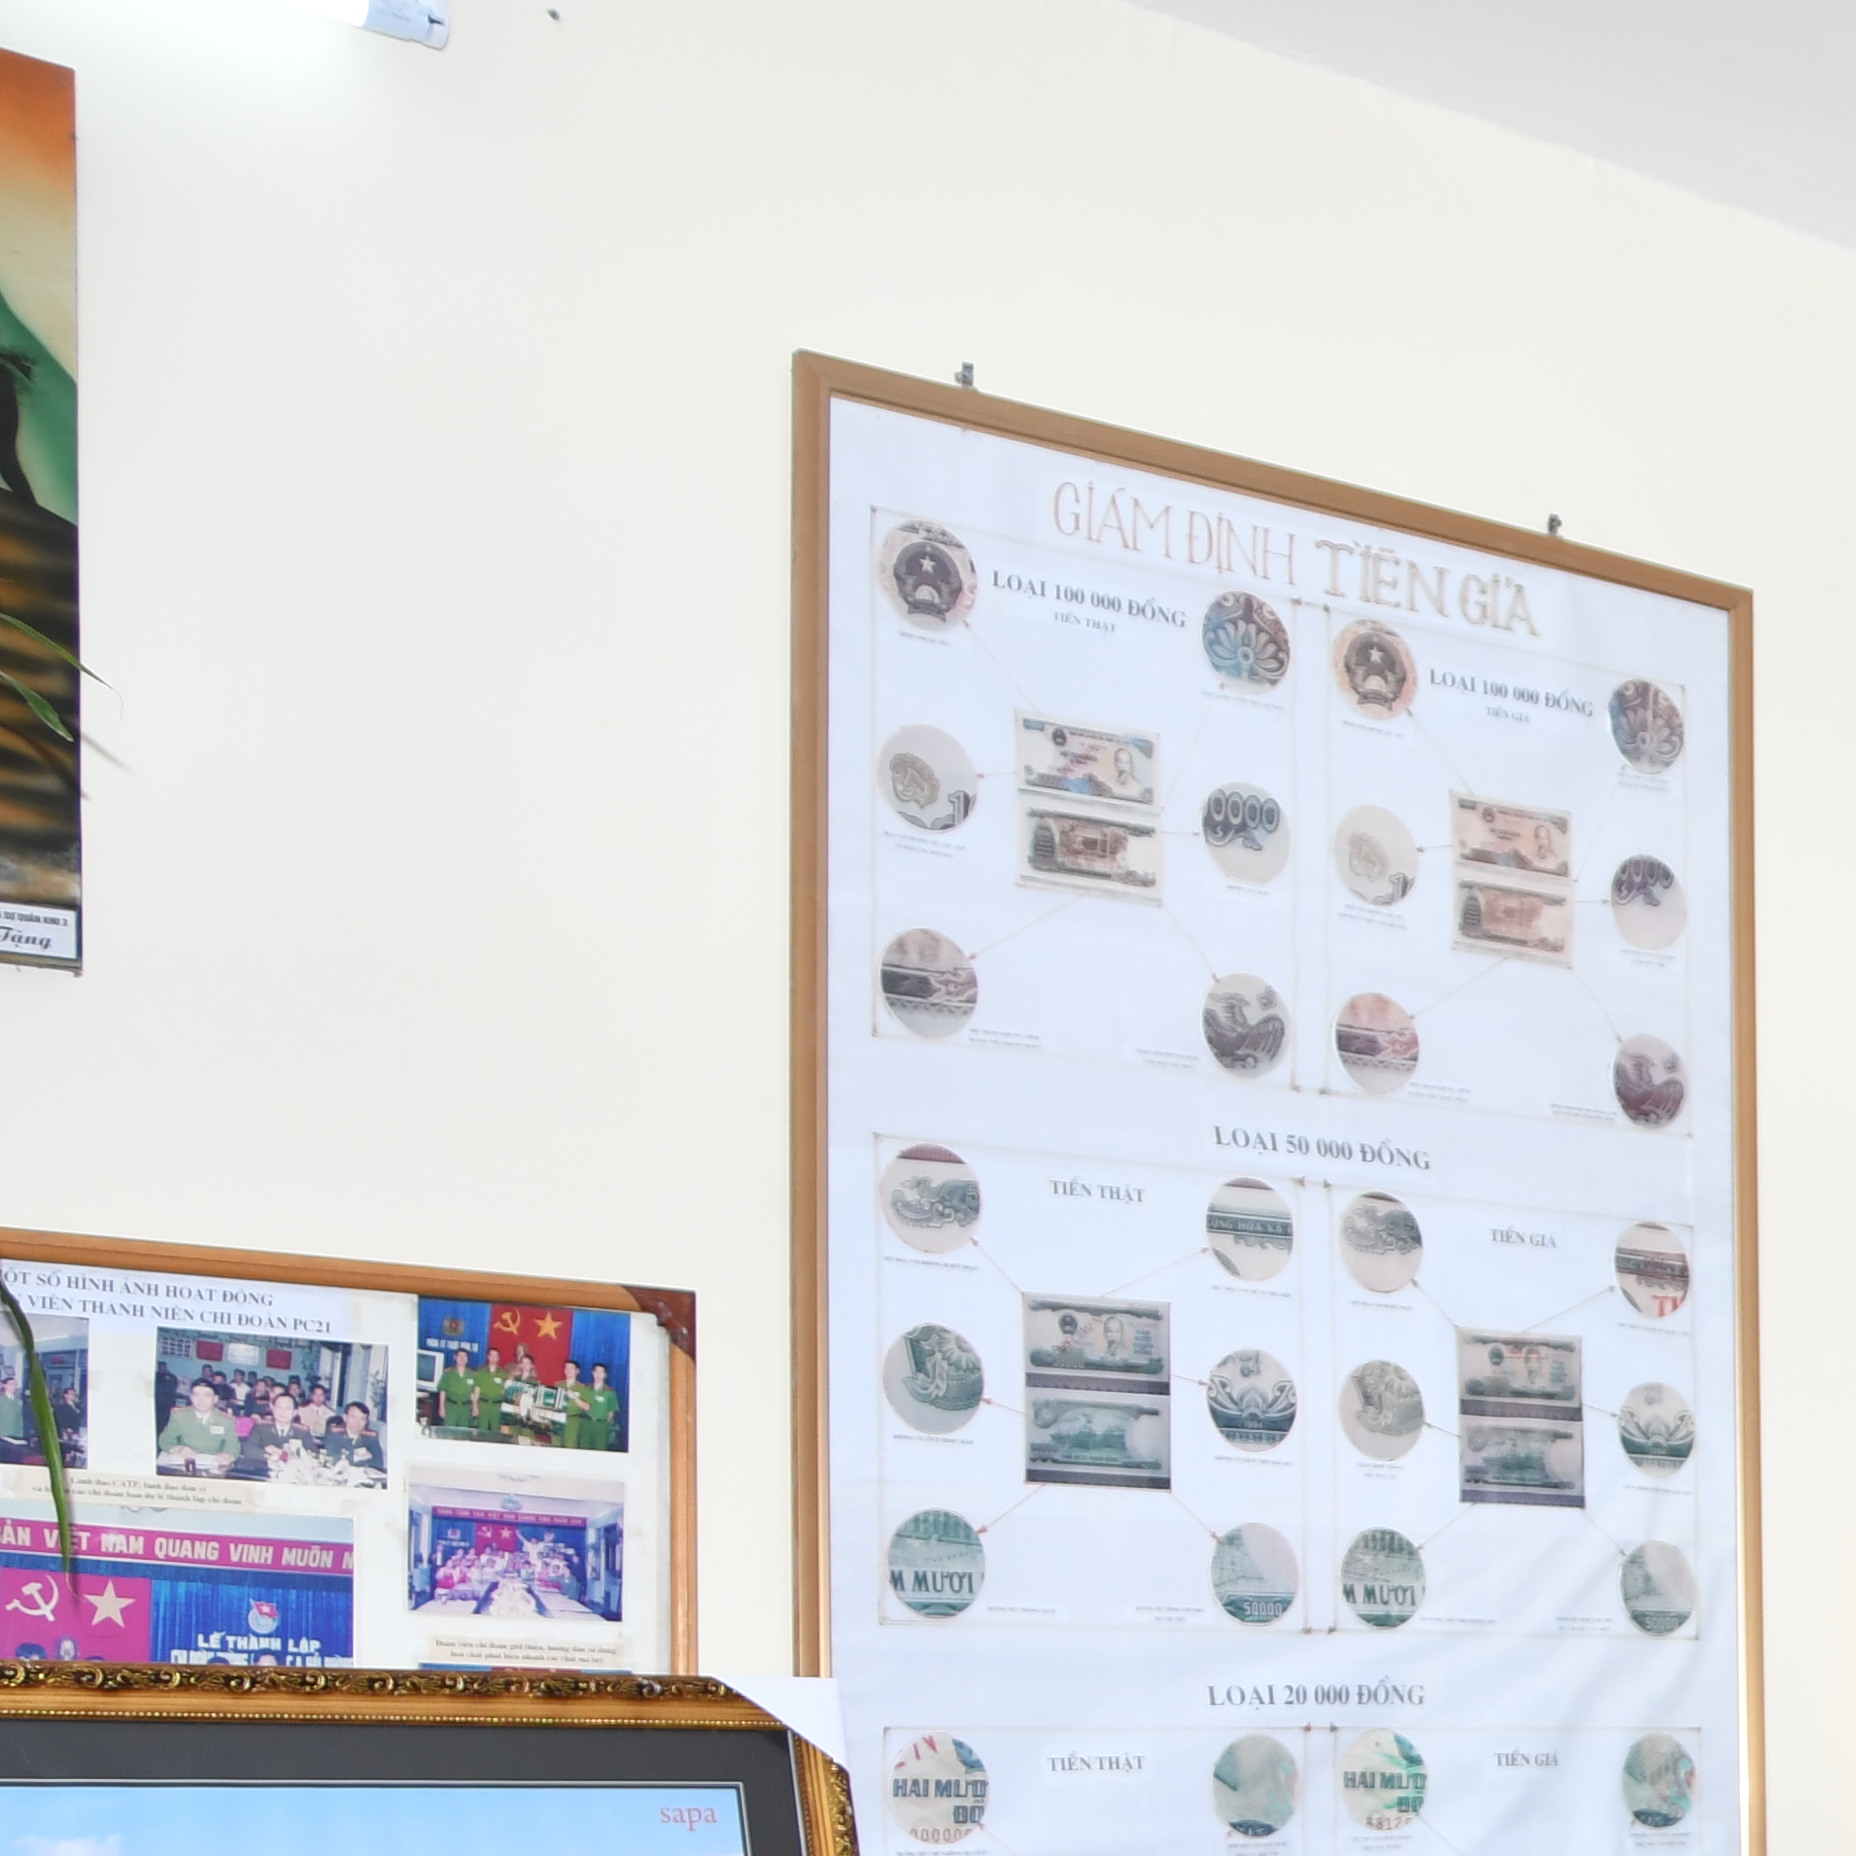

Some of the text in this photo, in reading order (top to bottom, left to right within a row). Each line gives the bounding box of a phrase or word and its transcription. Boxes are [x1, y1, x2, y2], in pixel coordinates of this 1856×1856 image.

[992, 570, 1187, 629] LOẠI 100 000 ĐỒNG
[1214, 1125, 1431, 1170] LOẠI 50 000 ĐỒNG
[1050, 1176, 1144, 1204] TIỀN THẬT
[37, 1271, 273, 1307] SỐ HÌNH ẢNH ĐỘNG
[28, 1293, 331, 1333] VIÊN THANH NIÊN CHI ĐOÀN PC21
[102, 1533, 333, 1569] NAM QUANG VINH MUÔN
[1208, 1676, 1424, 1711] LOẠI 20 000 ĐỒNG
[1048, 1750, 1145, 1772] TIỀN THẬT
[893, 1778, 928, 1799] HAI
[660, 1808, 717, 1831] sapa
